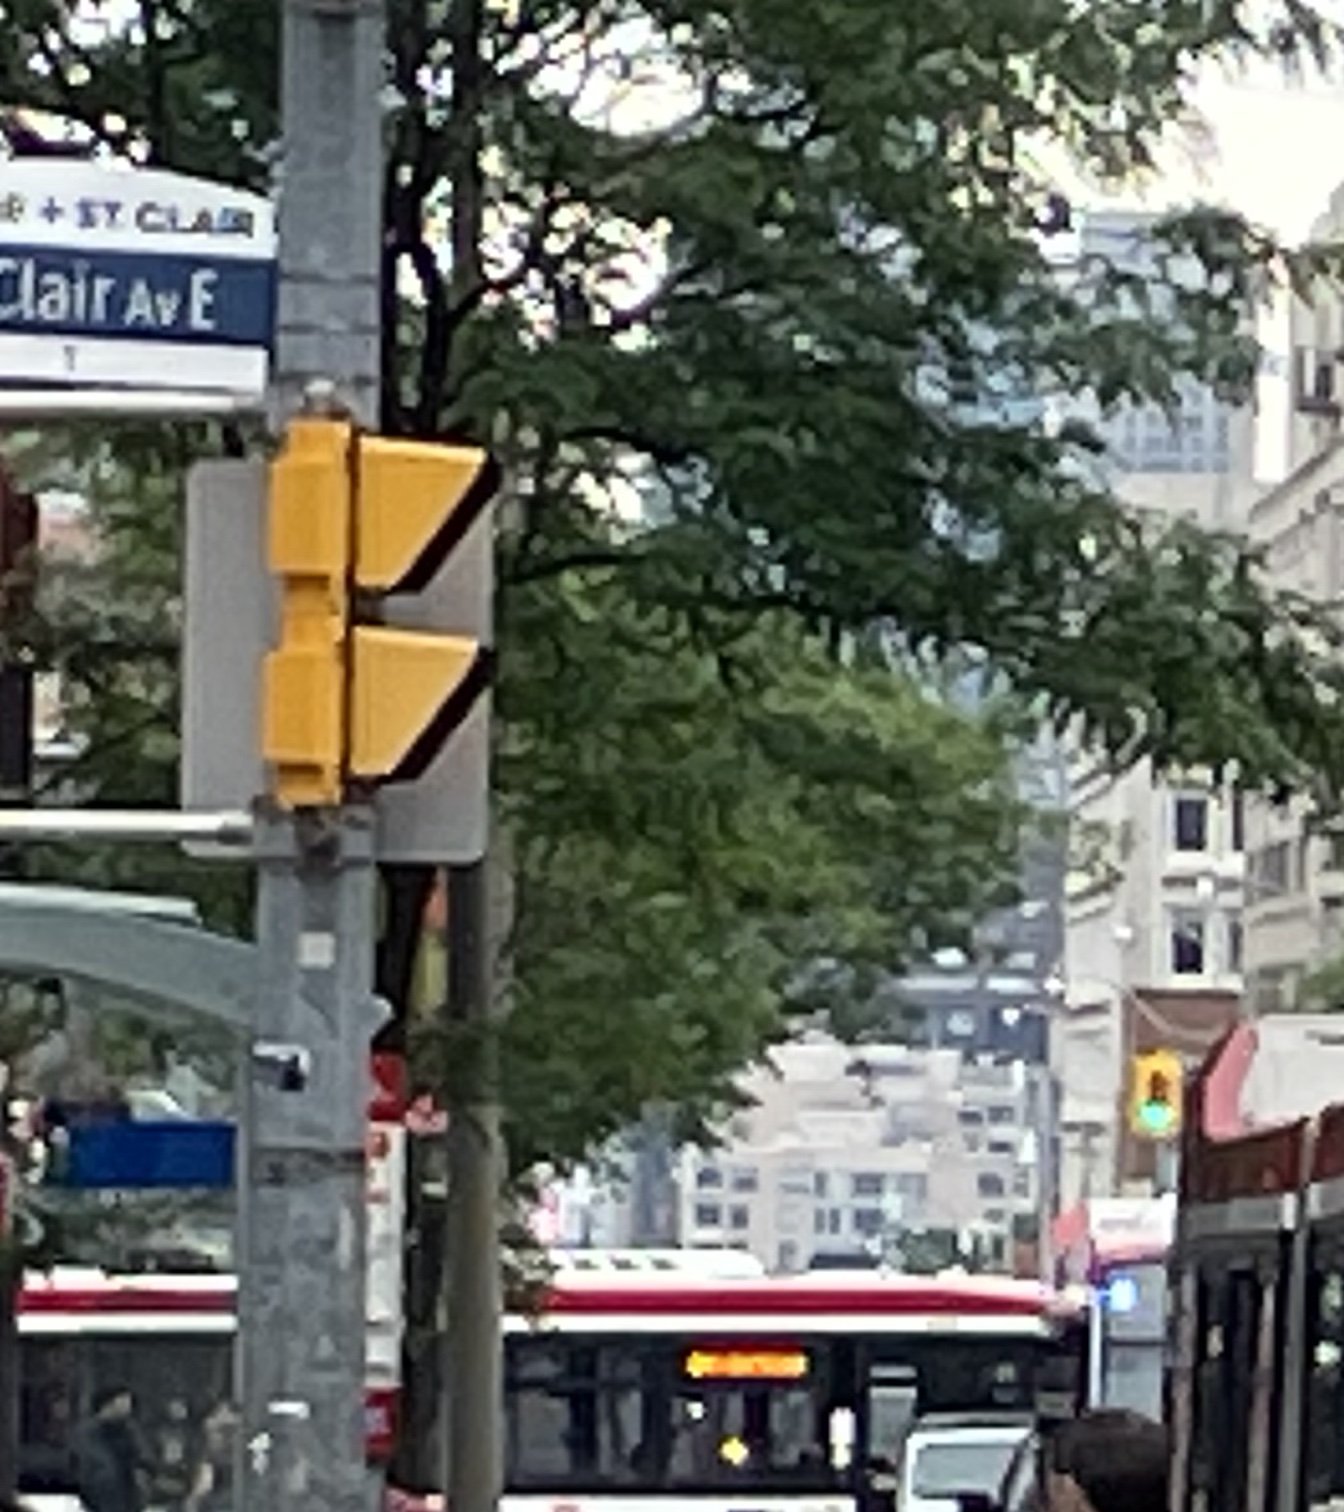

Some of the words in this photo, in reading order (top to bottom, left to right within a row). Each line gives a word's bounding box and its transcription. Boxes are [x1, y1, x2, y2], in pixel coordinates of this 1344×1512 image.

[135, 200, 254, 238] CLAIR
[0, 257, 116, 322] Clair
[190, 267, 219, 330] E
